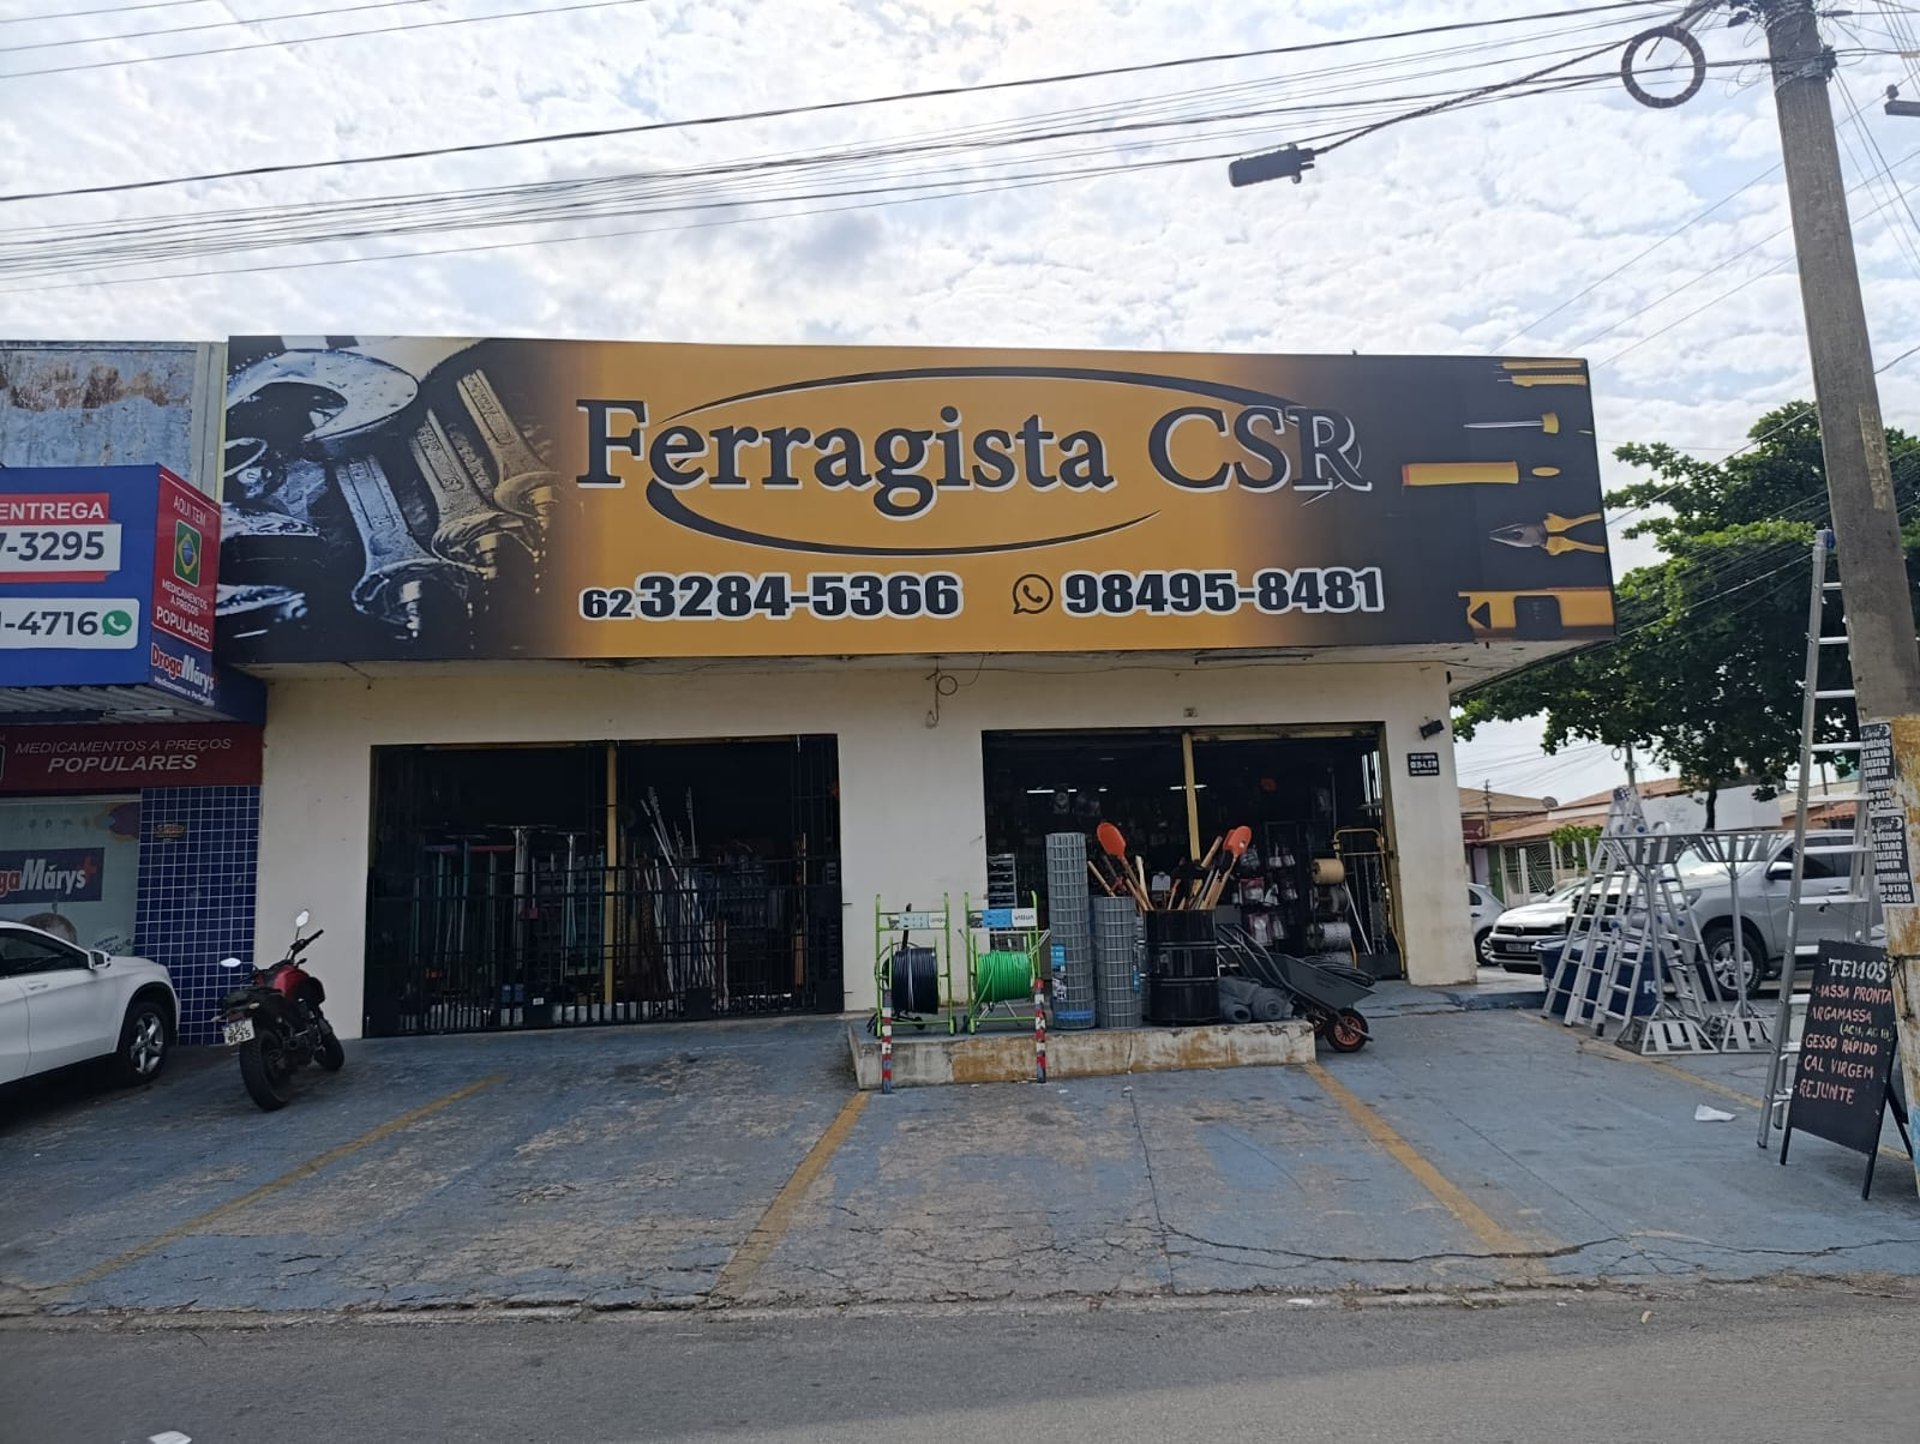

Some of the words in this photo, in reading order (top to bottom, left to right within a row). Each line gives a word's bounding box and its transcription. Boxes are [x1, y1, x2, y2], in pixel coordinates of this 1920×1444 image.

[575, 399, 1114, 521] Ferragista
[1147, 404, 1374, 495] CSR
[173, 495, 192, 517] AQUI
[192, 509, 206, 528] TEM
[162, 578, 208, 610] MEDICAMENTOS
[581, 588, 633, 620] 62
[634, 571, 964, 619] 3284-5366
[1065, 566, 1384, 616] 98495-8481
[0, 611, 98, 636] -4716
[156, 605, 210, 643] POPULARES
[16, 740, 147, 754] MEDICAMENTOS
[148, 739, 161, 750] A
[164, 737, 233, 753] PREÇOS
[48, 754, 199, 774] POPULARES
[1853, 986, 1892, 1005] PRONTA
[1805, 1033, 1838, 1050] GESSO
[1841, 1036, 1878, 1056] RÁPIDO
[1804, 1054, 1825, 1072] CAL
[1830, 1058, 1874, 1080] VIRGEM
[1799, 1078, 1855, 1105] REJUNTE
